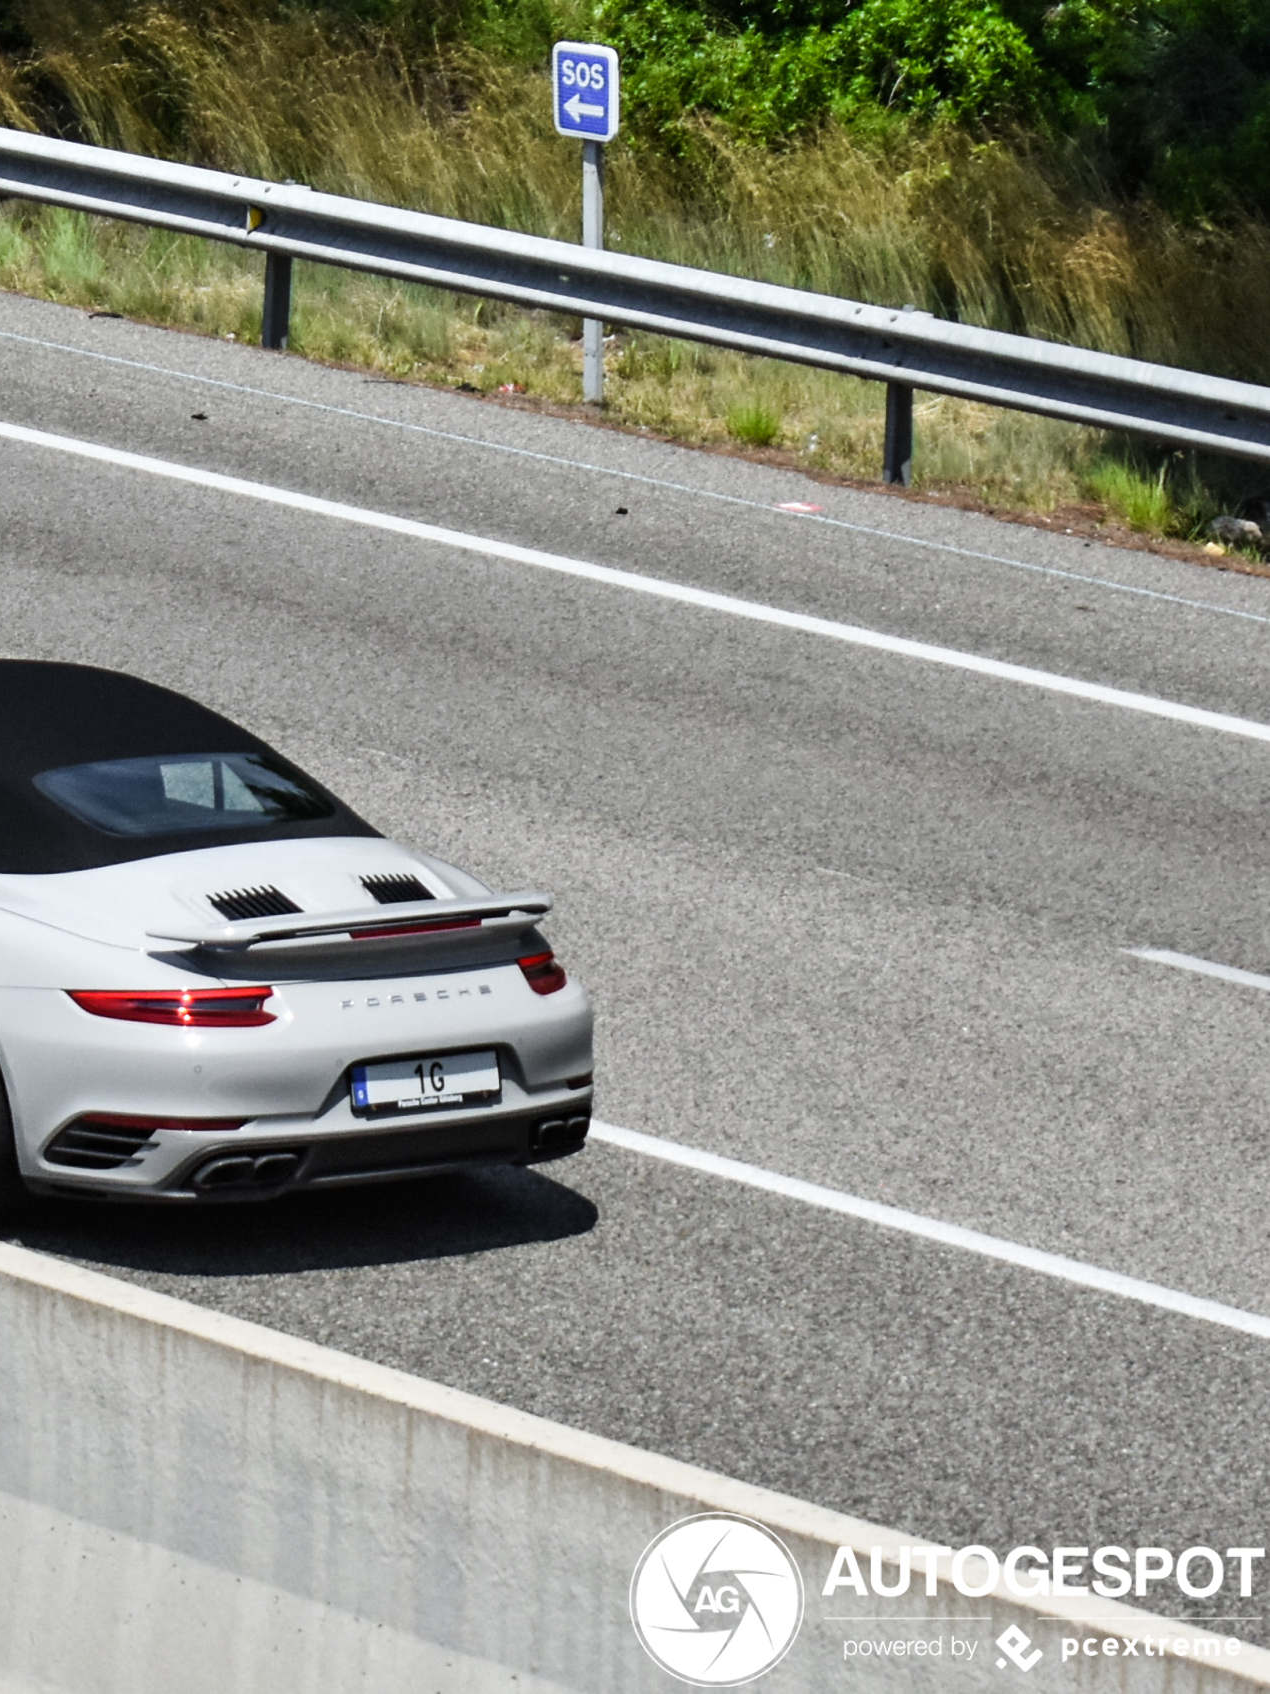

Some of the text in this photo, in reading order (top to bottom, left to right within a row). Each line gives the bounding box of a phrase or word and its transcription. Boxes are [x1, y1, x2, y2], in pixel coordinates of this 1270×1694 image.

[562, 59, 604, 89] SOS
[341, 984, 492, 1009] PORSCHE
[414, 1061, 445, 1094] 1G
